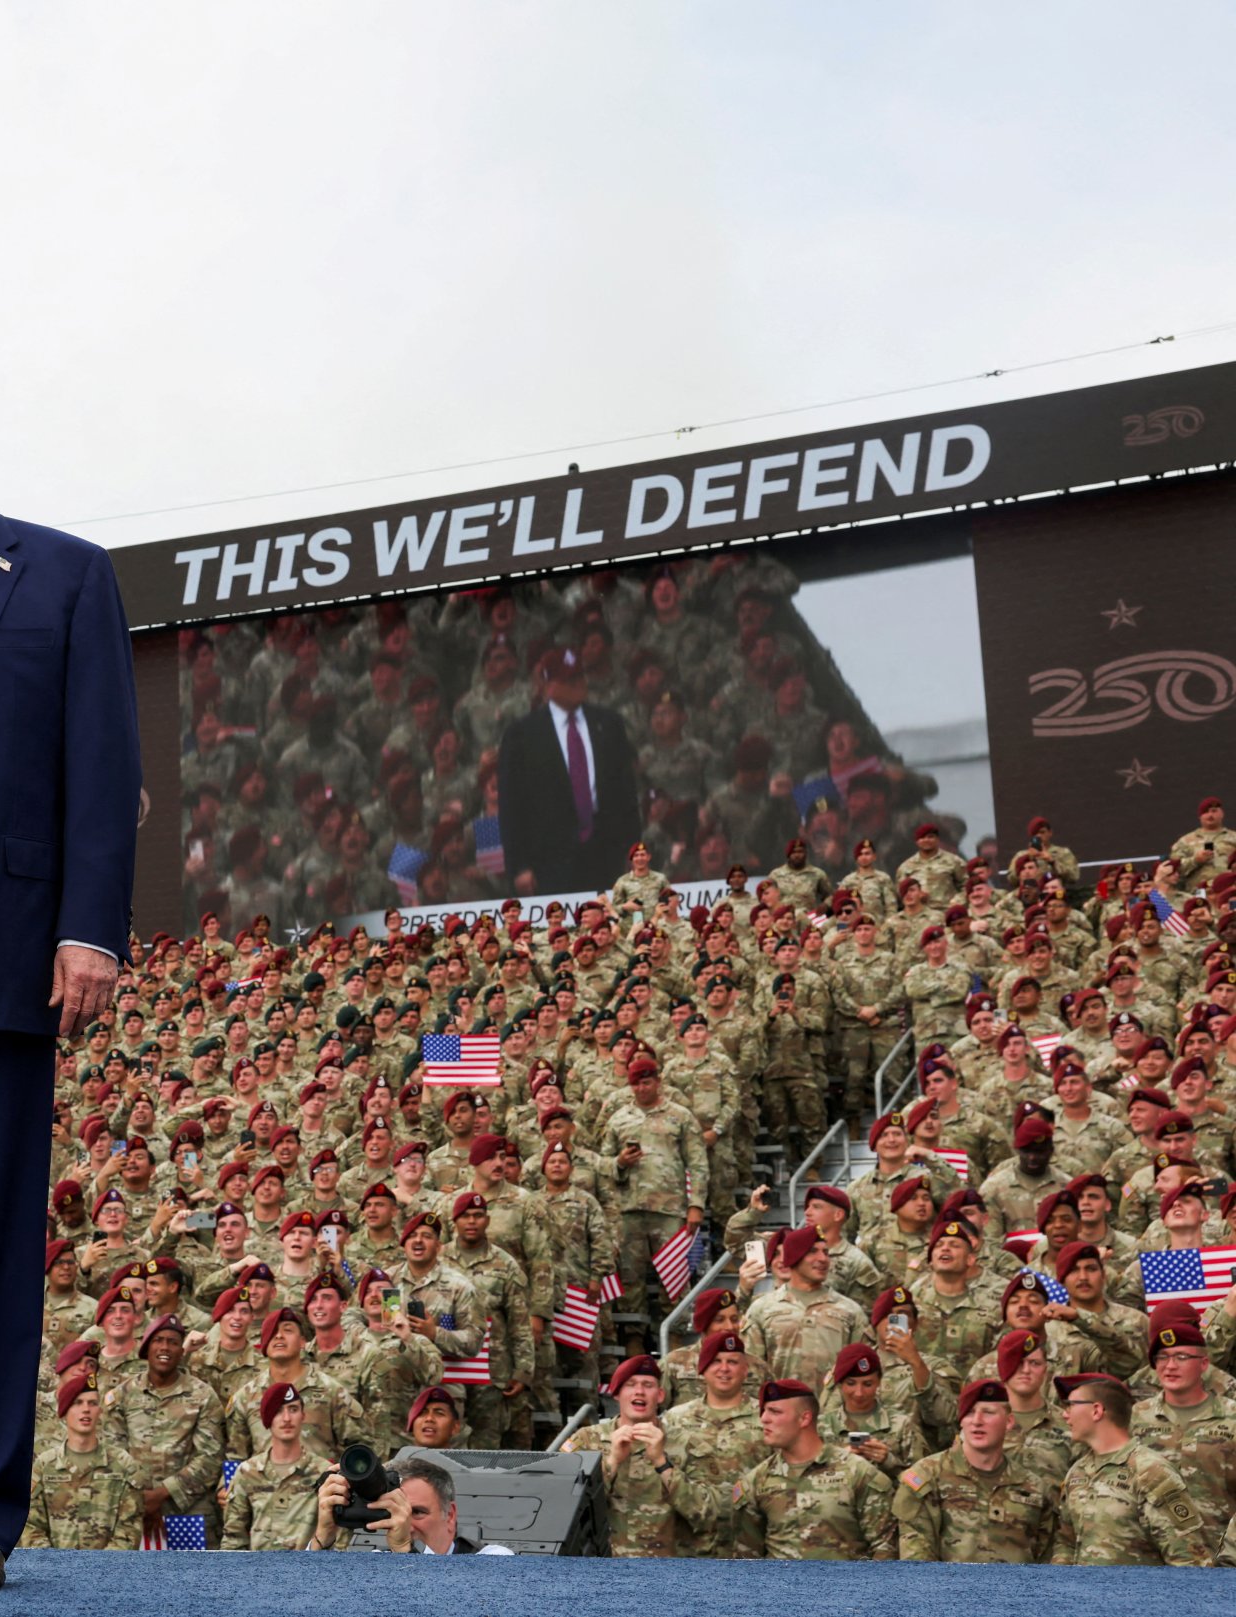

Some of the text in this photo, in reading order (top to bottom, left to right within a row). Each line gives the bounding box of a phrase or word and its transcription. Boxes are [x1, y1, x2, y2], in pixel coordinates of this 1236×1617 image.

[1121, 405, 1205, 446] 250
[174, 424, 991, 605] THIS WE'LL DEFEND
[1028, 649, 1236, 737] 250
